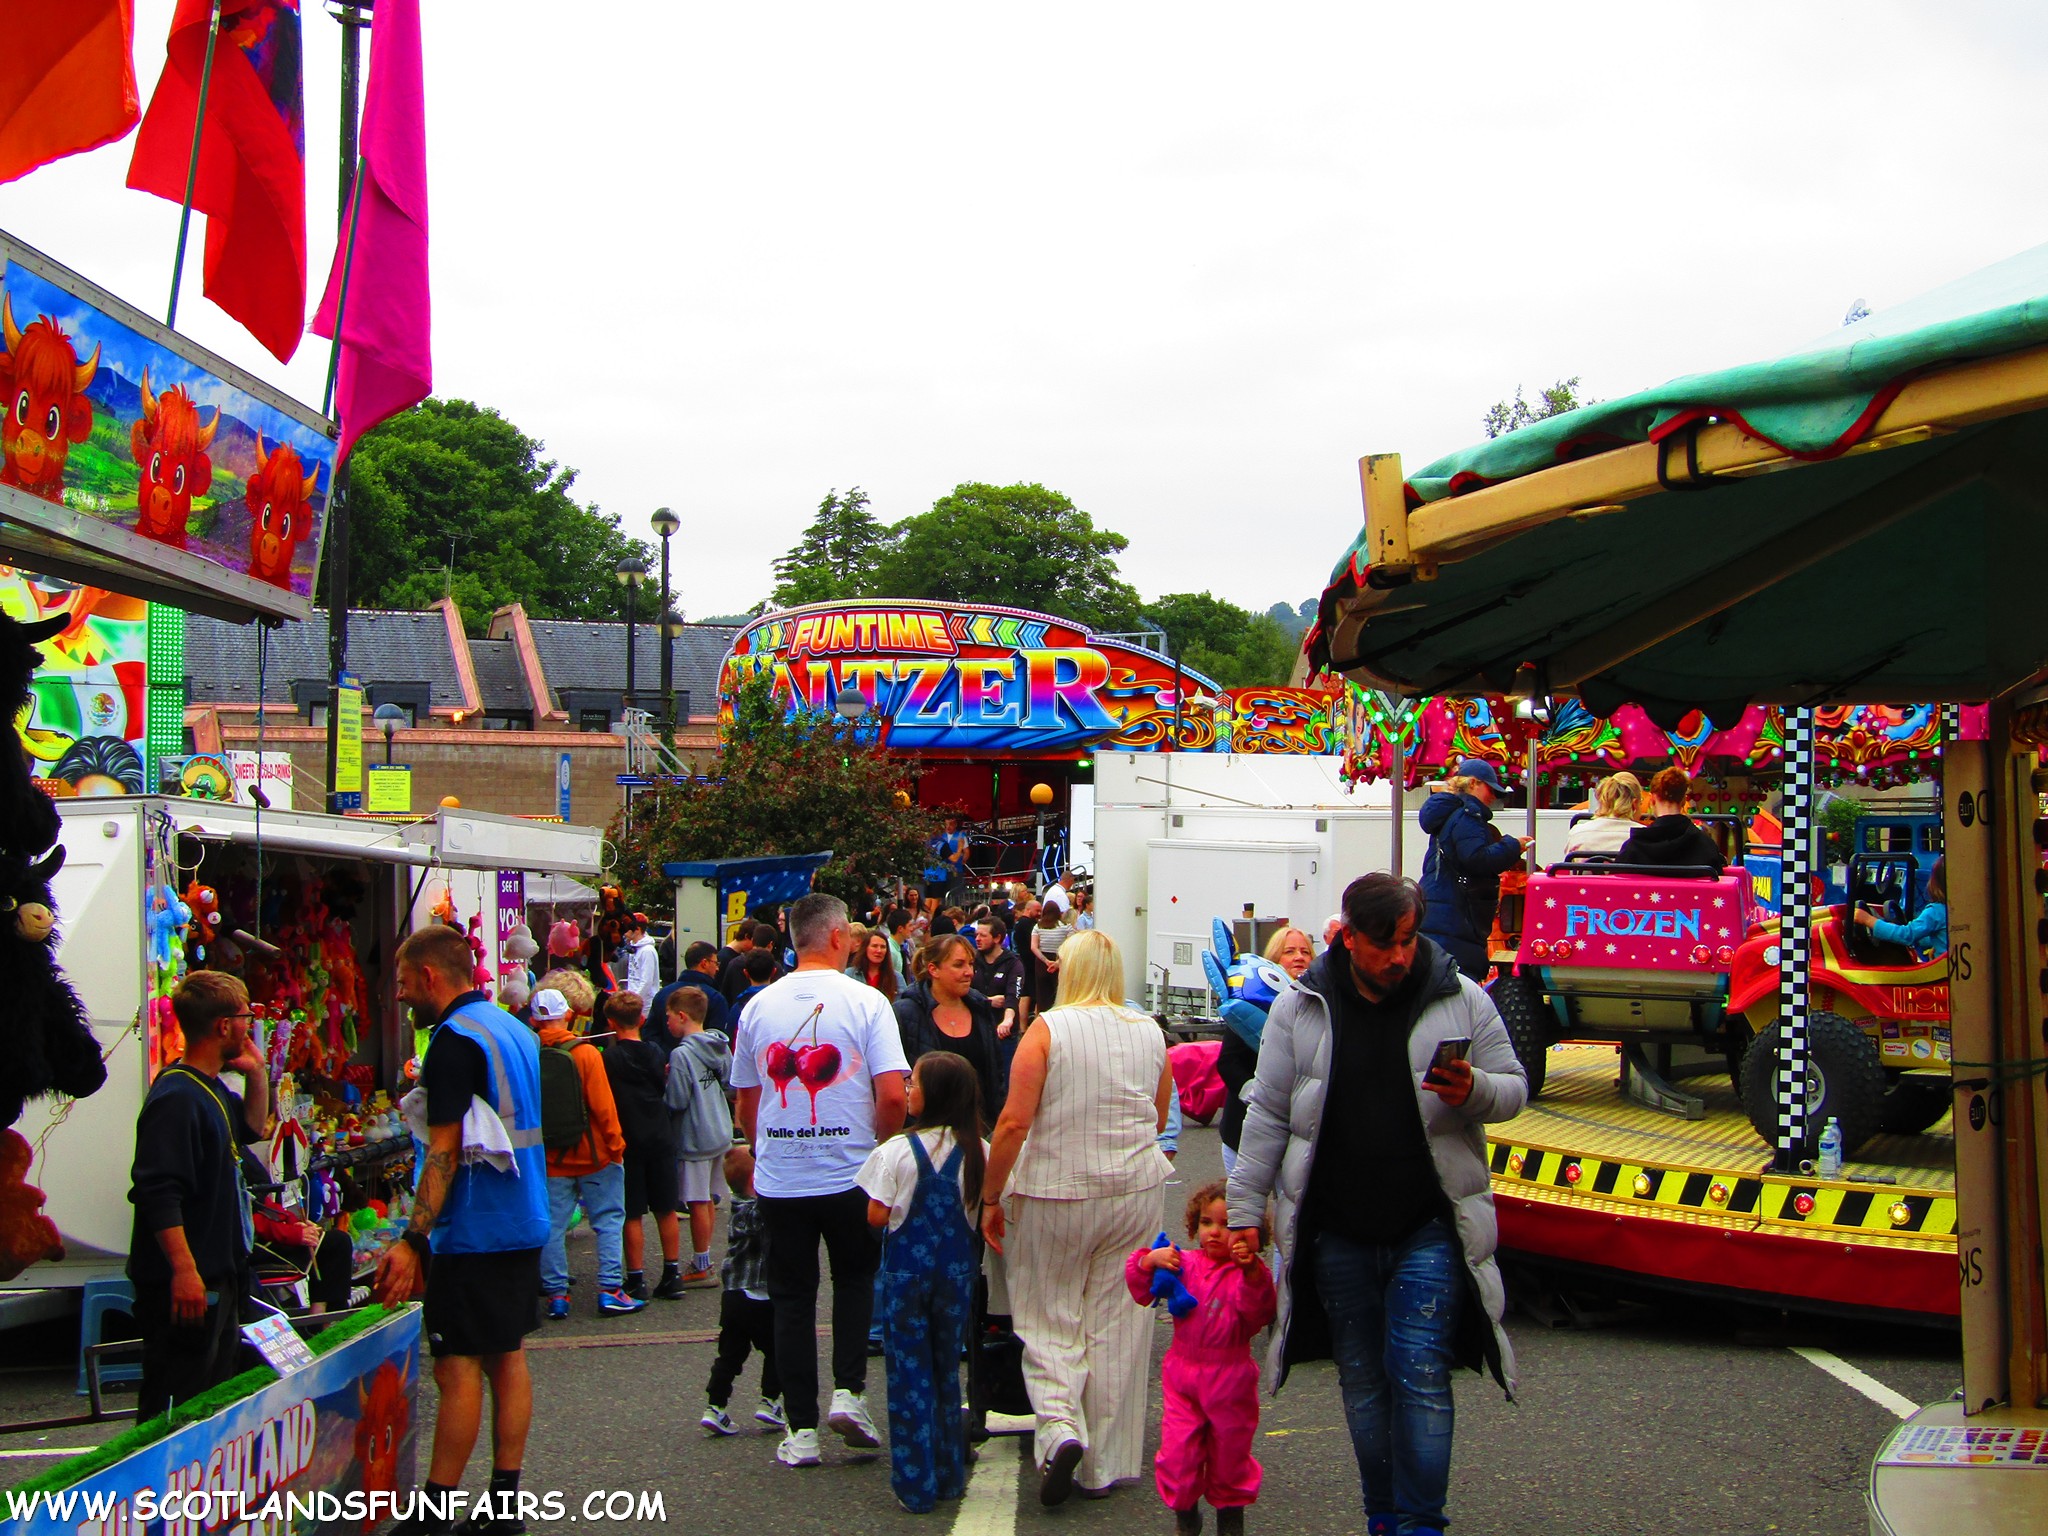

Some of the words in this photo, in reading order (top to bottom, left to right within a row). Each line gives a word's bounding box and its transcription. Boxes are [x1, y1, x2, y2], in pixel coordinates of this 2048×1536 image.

[791, 611, 951, 656] FUNTIME
[235, 763, 255, 779] SWEETS
[261, 763, 273, 780] COLD
[274, 763, 291, 779] DRINKS
[501, 880, 513, 893] SEE
[514, 881, 519, 893] IT
[1565, 904, 1701, 940] FROZEN
[1893, 986, 1949, 1013] IRON
[766, 1127, 794, 1138] Valle
[797, 1127, 816, 1138] del
[818, 1126, 850, 1137] Jerte
